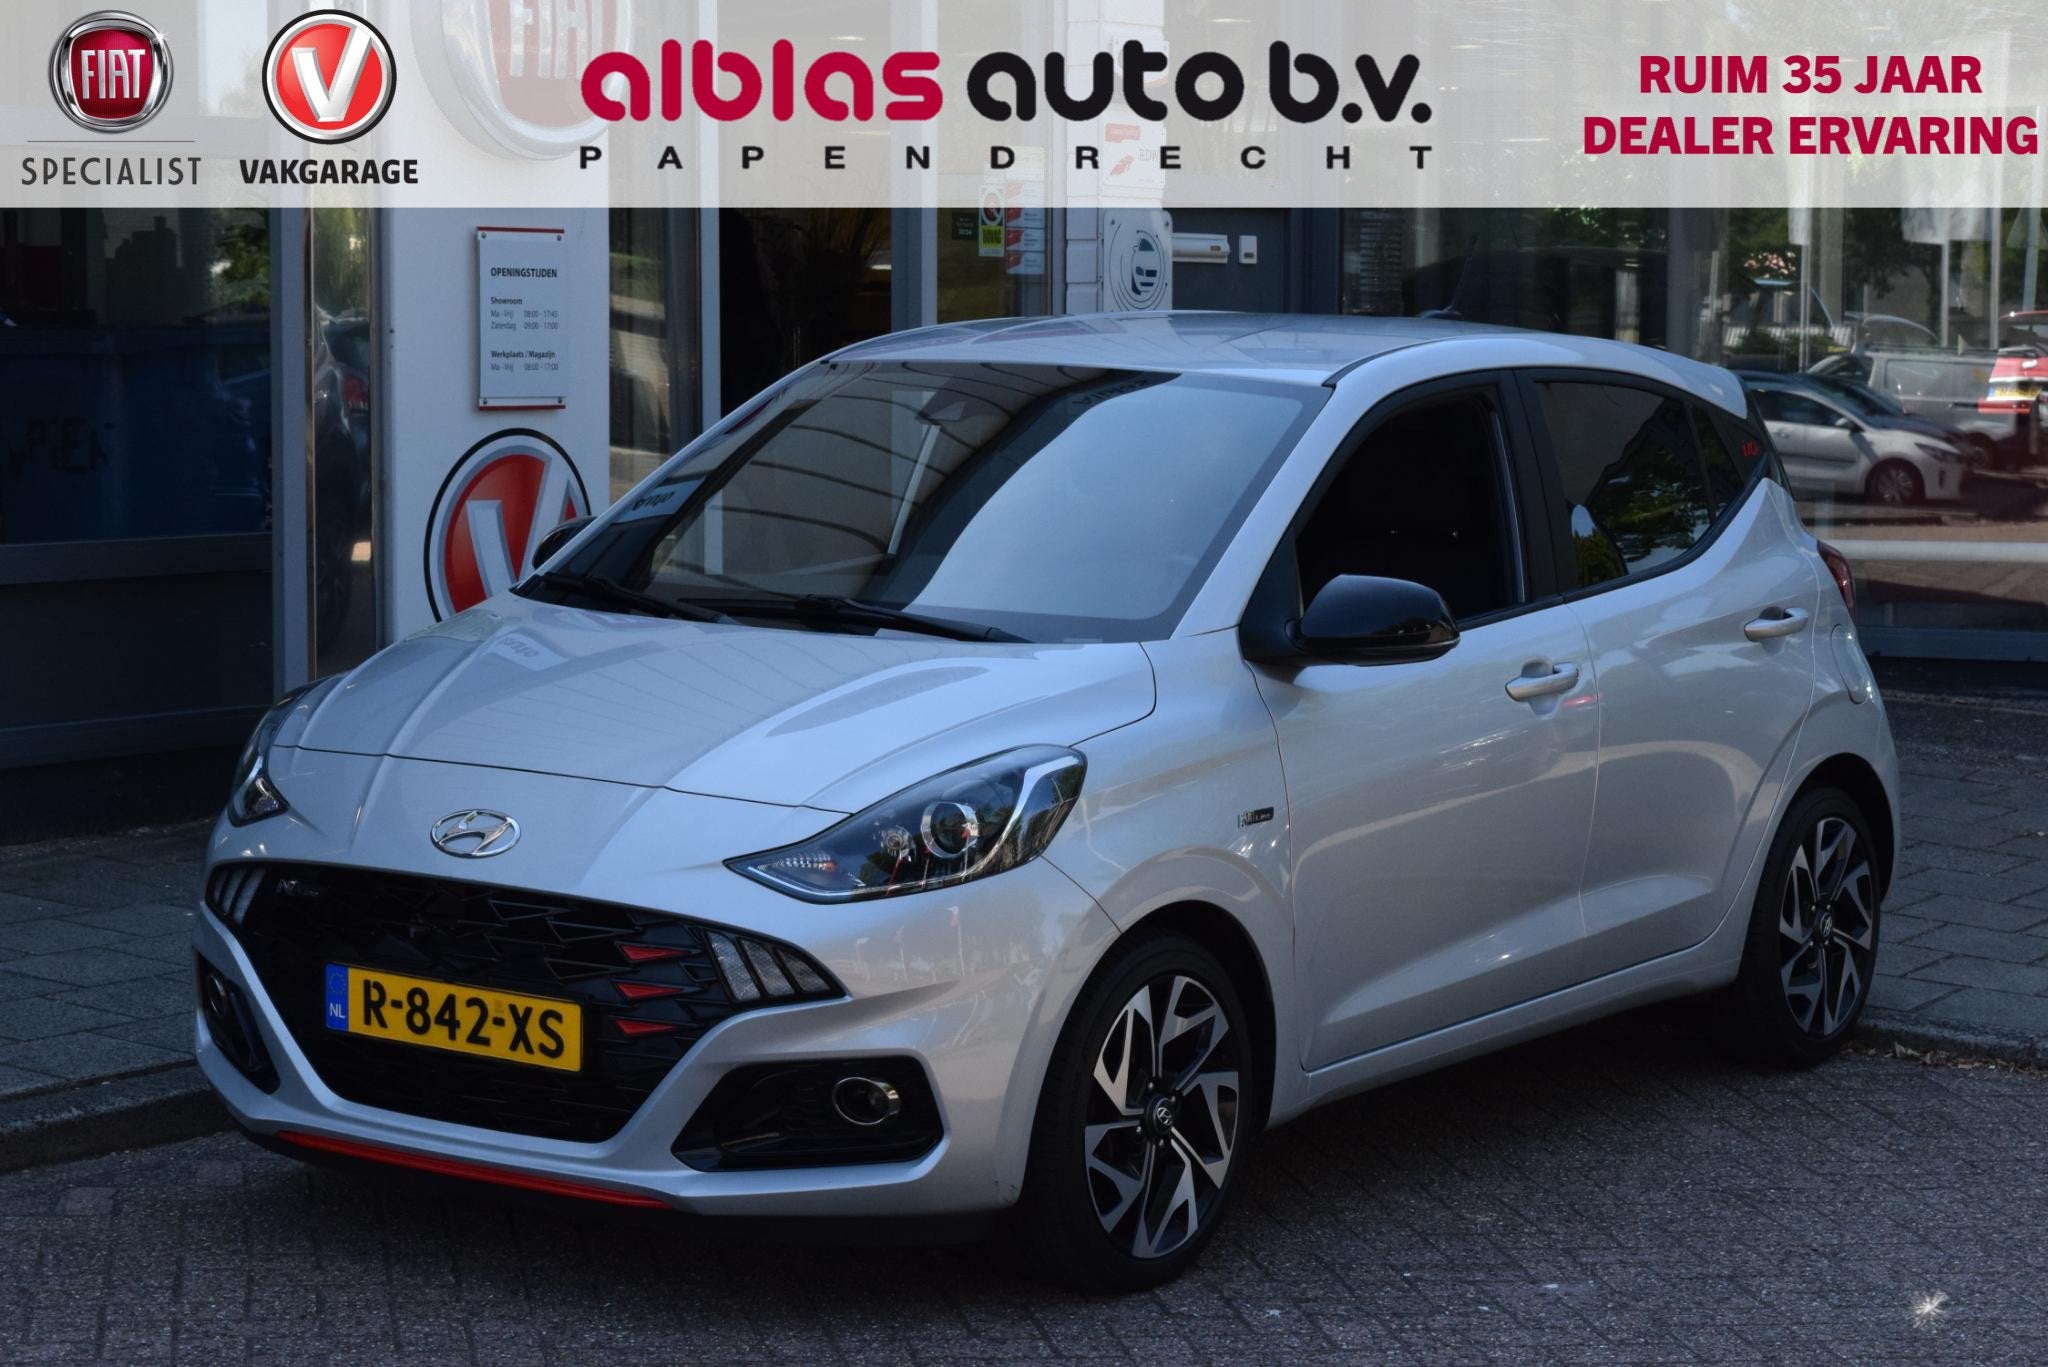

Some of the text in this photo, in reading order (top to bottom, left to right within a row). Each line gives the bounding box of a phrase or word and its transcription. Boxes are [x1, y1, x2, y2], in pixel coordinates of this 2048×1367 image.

[490, 267, 558, 278] OPENINGSTIJDEN
[490, 296, 523, 305] Showroom
[490, 350, 556, 359] Werkplaats Magazijn
[329, 1002, 346, 1019] NL
[361, 979, 566, 1059] R-842-XS
